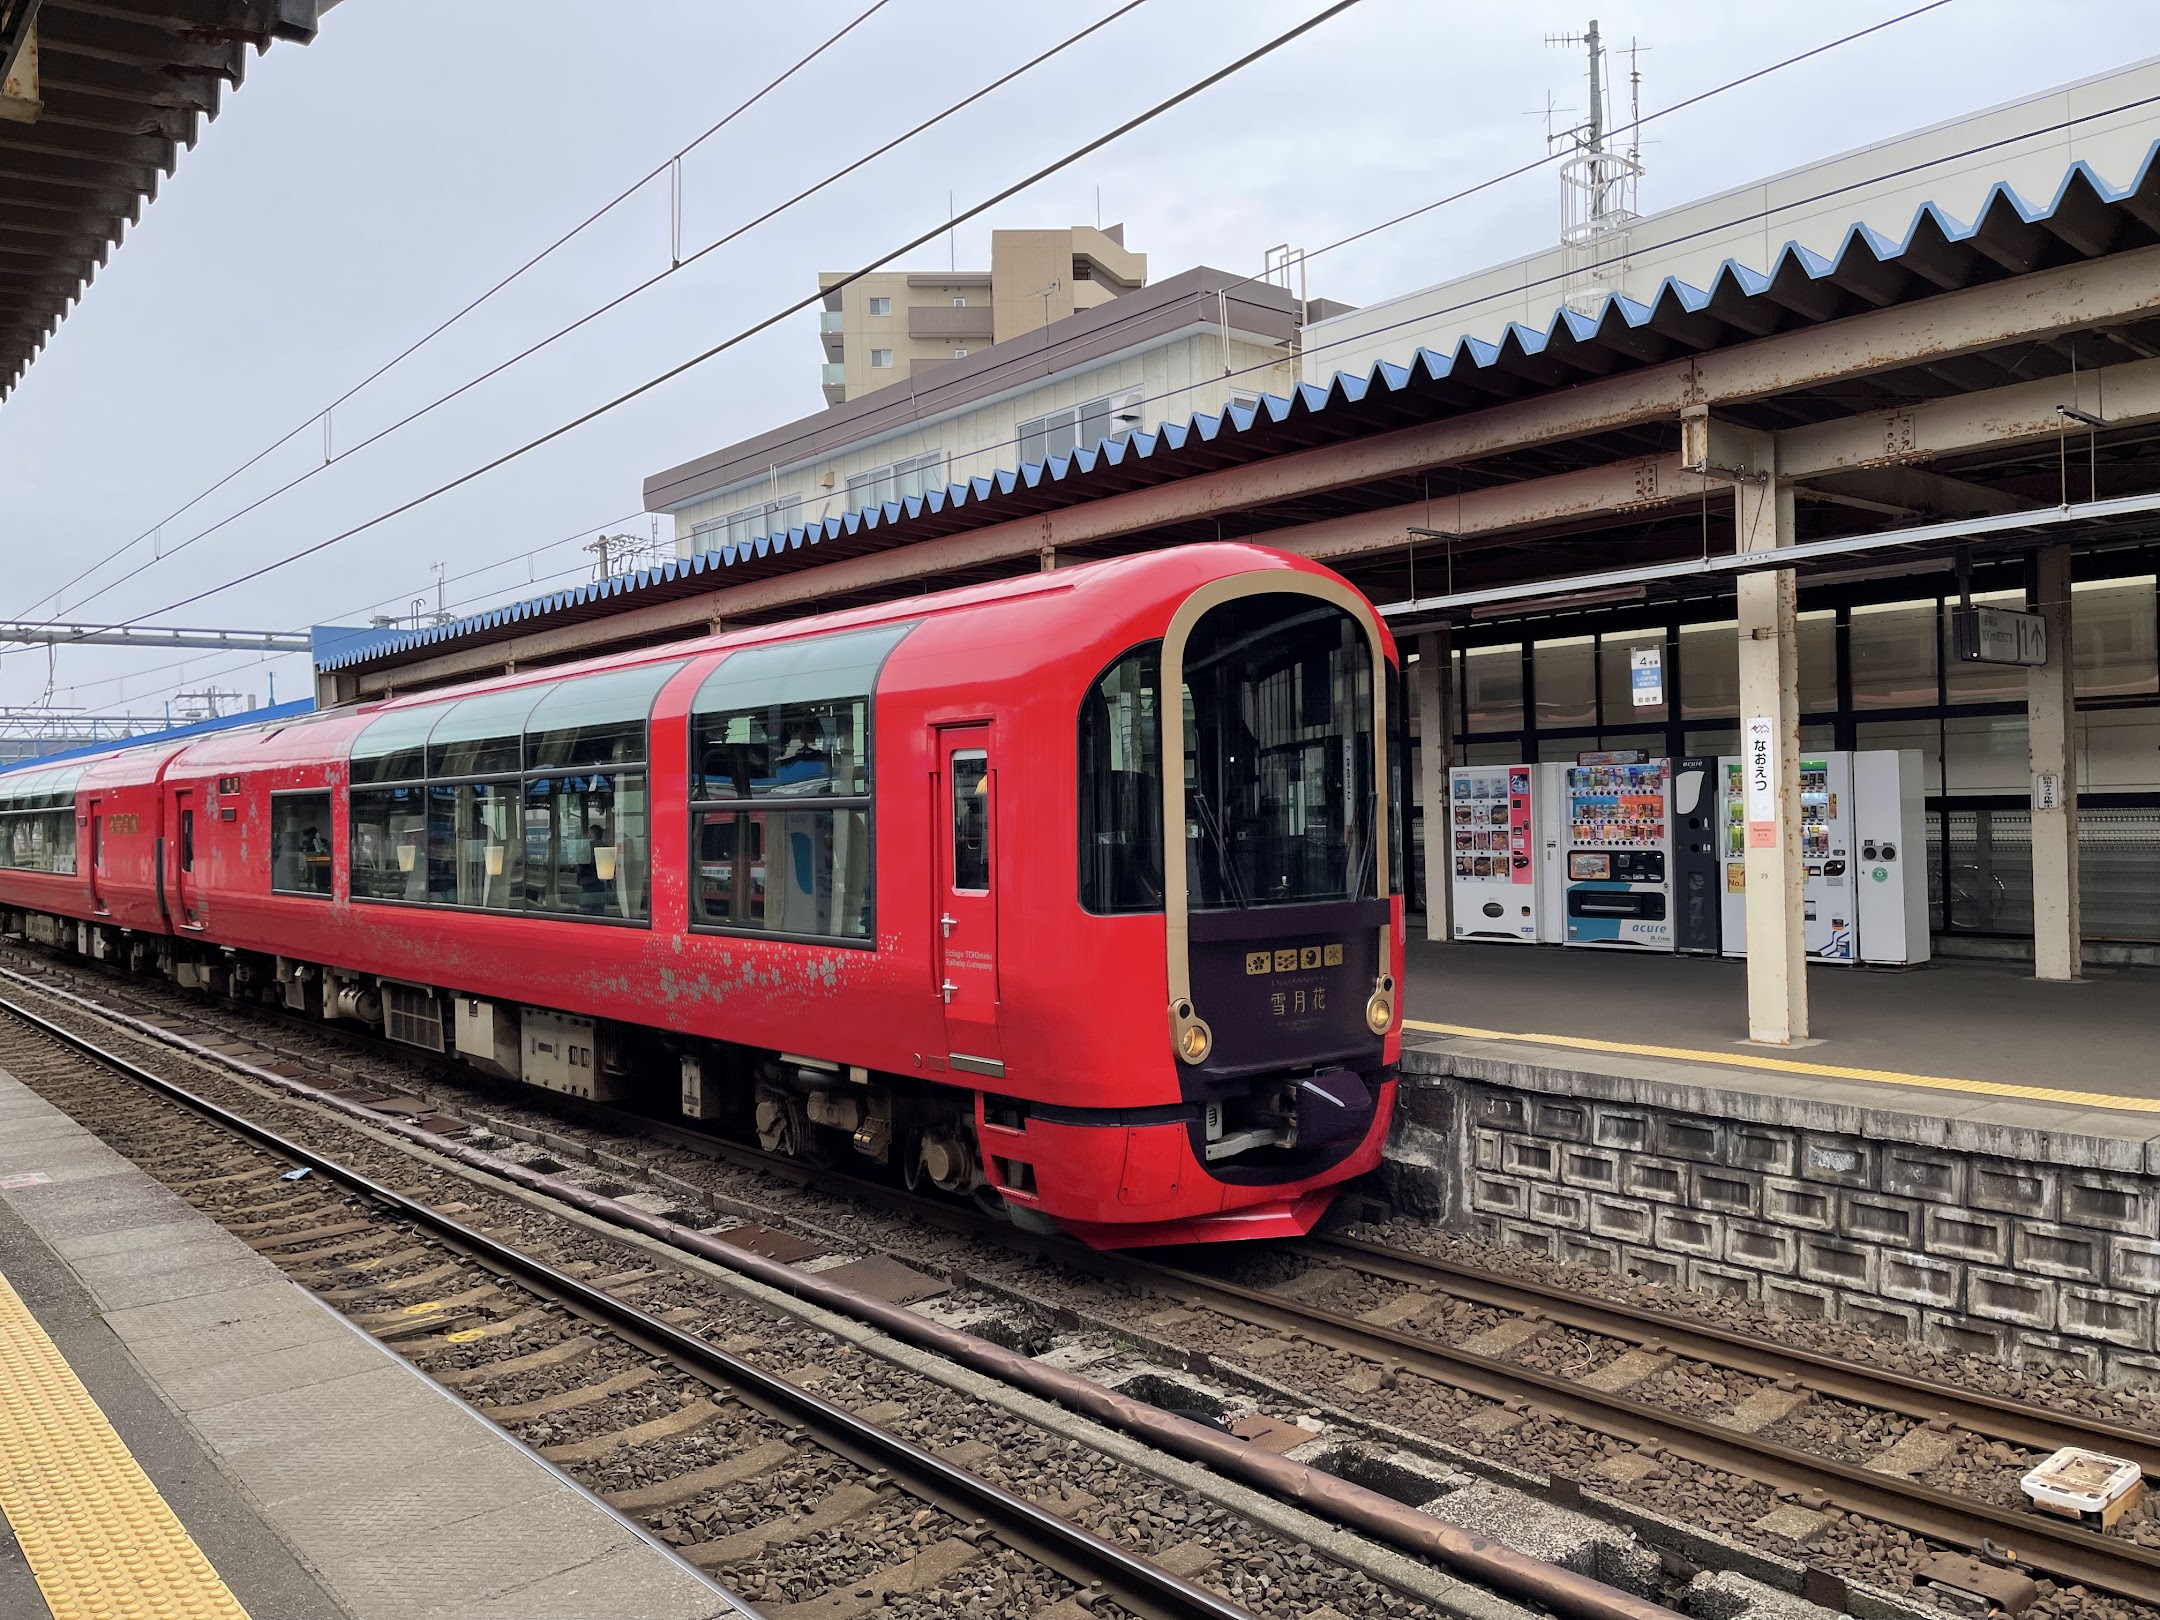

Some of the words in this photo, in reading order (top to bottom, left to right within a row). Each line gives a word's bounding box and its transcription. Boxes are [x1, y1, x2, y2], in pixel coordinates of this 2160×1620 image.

[1754, 740, 1767, 791] なおえつ
[1632, 924, 1667, 934] acure
[1271, 987, 1325, 1015] 雪月花
